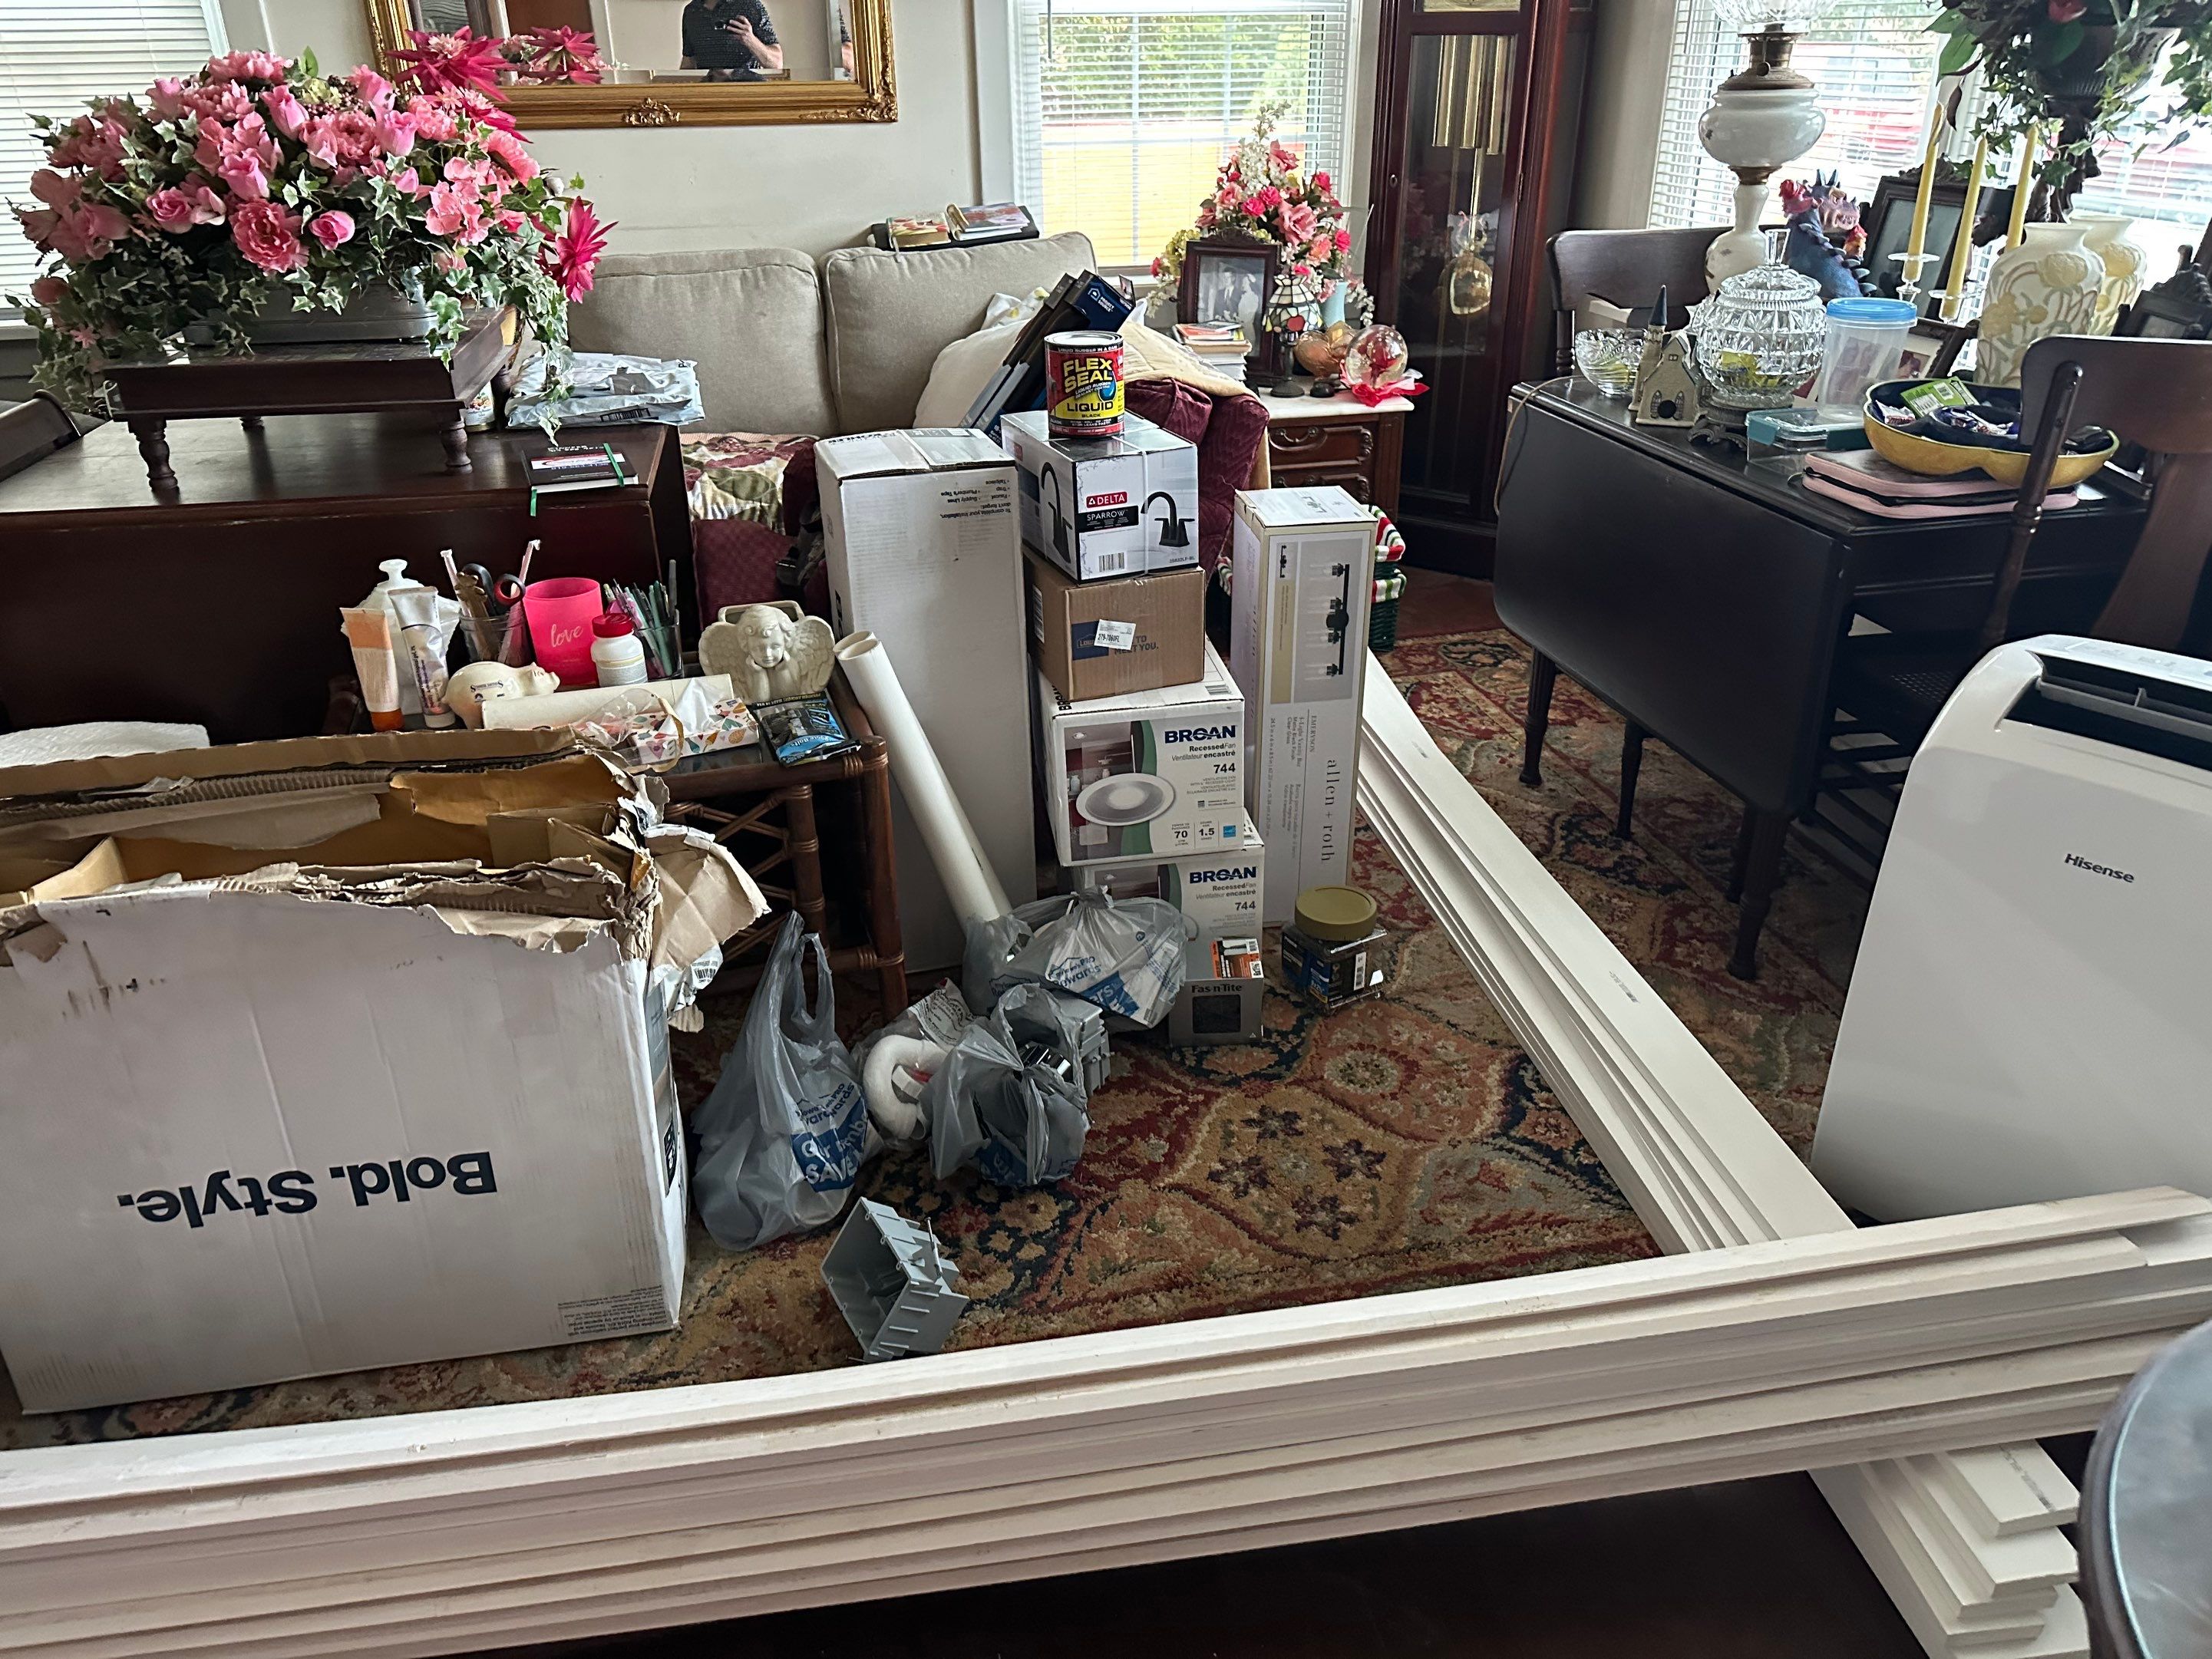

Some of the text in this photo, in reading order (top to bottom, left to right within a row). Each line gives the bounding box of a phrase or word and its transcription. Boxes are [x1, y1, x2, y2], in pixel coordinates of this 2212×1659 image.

[1063, 358, 1113, 377] FLEX
[1065, 370, 1113, 393] SEAL
[1066, 401, 1114, 412] LIQUID
[1097, 493, 1125, 506] DELTA
[551, 624, 583, 648] love
[1136, 635, 1147, 643] TO
[1164, 725, 1236, 744] BROAN
[1203, 750, 1236, 759] encastré
[1213, 763, 1236, 773] 744
[1326, 759, 1340, 806] allen
[1174, 830, 1188, 839] 70
[1198, 828, 1215, 836] 1.5
[1321, 825, 1336, 862] roth
[1190, 866, 1256, 884] BROAN
[2065, 853, 2135, 883] Hisense
[1235, 901, 1256, 911] 744
[117, 1151, 498, 1228] Bold. Style.
